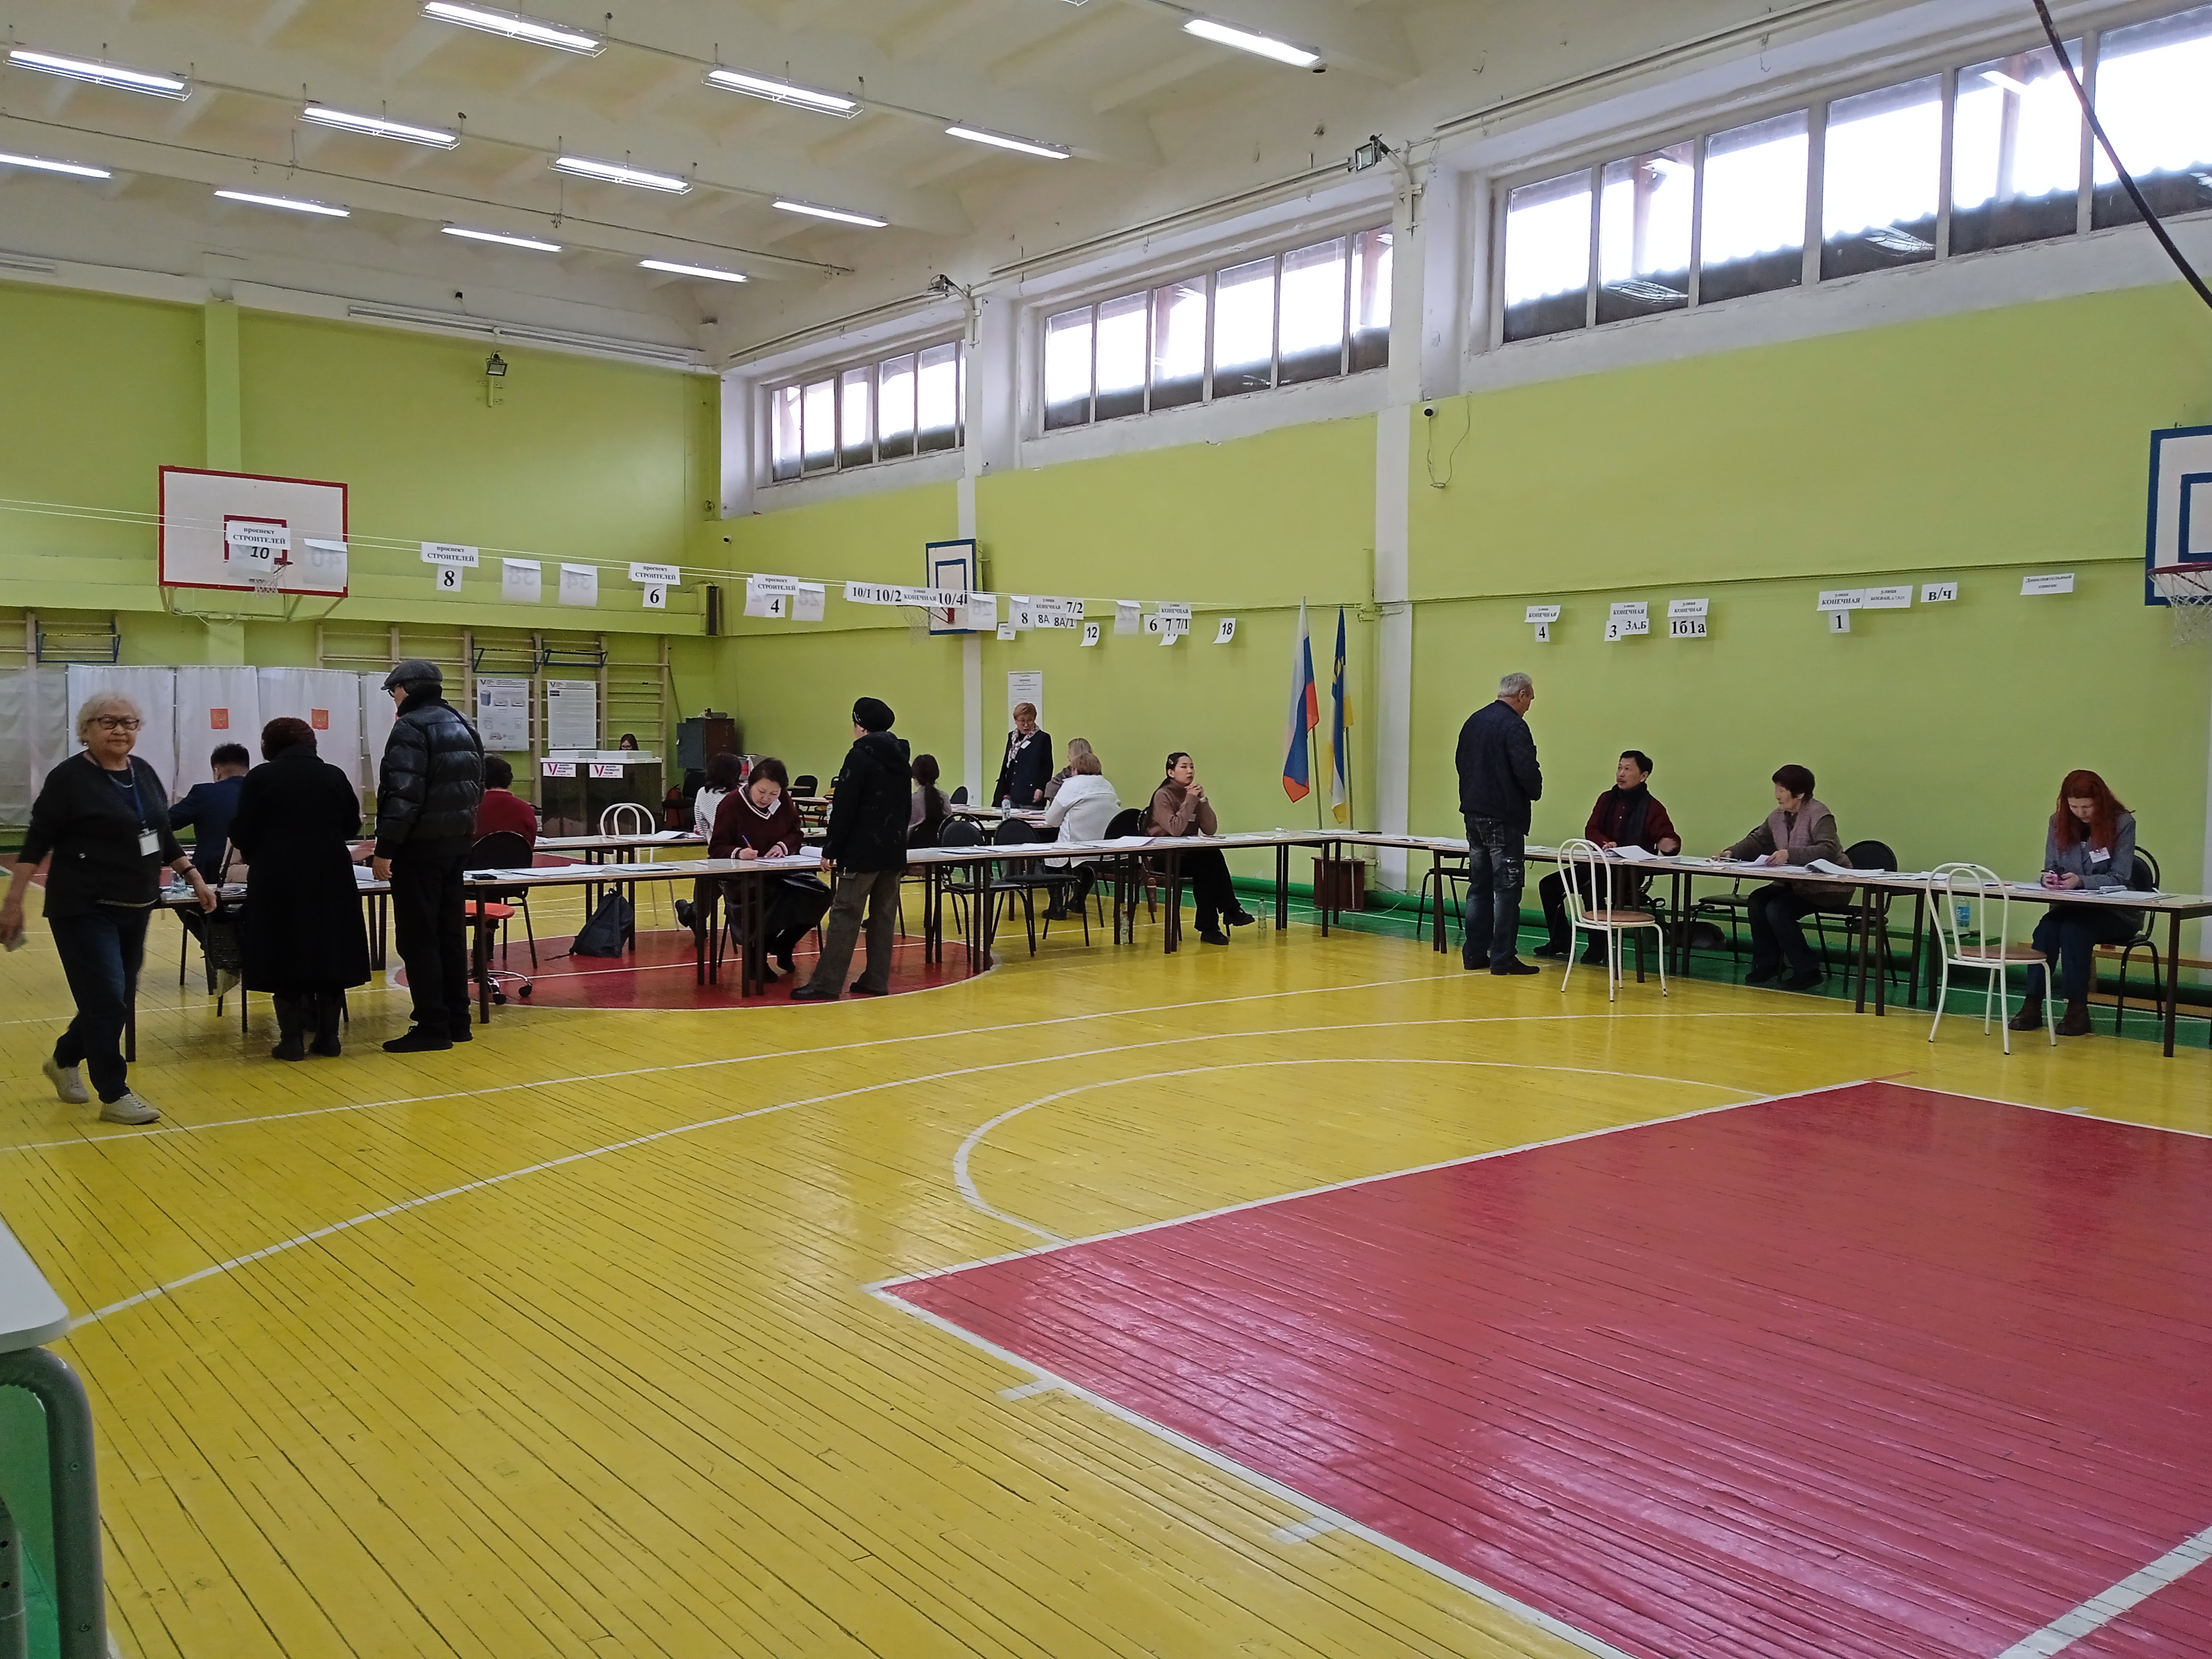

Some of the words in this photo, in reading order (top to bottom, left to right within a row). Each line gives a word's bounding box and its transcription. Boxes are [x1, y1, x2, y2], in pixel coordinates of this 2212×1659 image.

[233, 534, 286, 544] СТРОИТЕЛЕЙ
[250, 546, 270, 559] 10
[427, 553, 474, 562] СТРОИТЕЛЕЙ
[443, 570, 455, 586] 8
[650, 588, 660, 604] 6
[853, 587, 871, 598] 10/1
[875, 589, 902, 602] 10/2
[939, 592, 963, 606] 10/4
[770, 598, 780, 613] 4
[1067, 601, 1083, 614] 7/2
[1021, 612, 1028, 624] 8
[1038, 614, 1050, 624] 8А
[1150, 618, 1158, 631] 6
[1165, 618, 1171, 631] 7
[1176, 618, 1188, 629] 7/1
[1835, 614, 1844, 629] 1
[1086, 626, 1097, 638] 12
[1222, 622, 1233, 635] 18
[1609, 624, 1617, 638] 3
[1625, 620, 1647, 631] 3А,Б
[1539, 626, 1546, 639] 4
